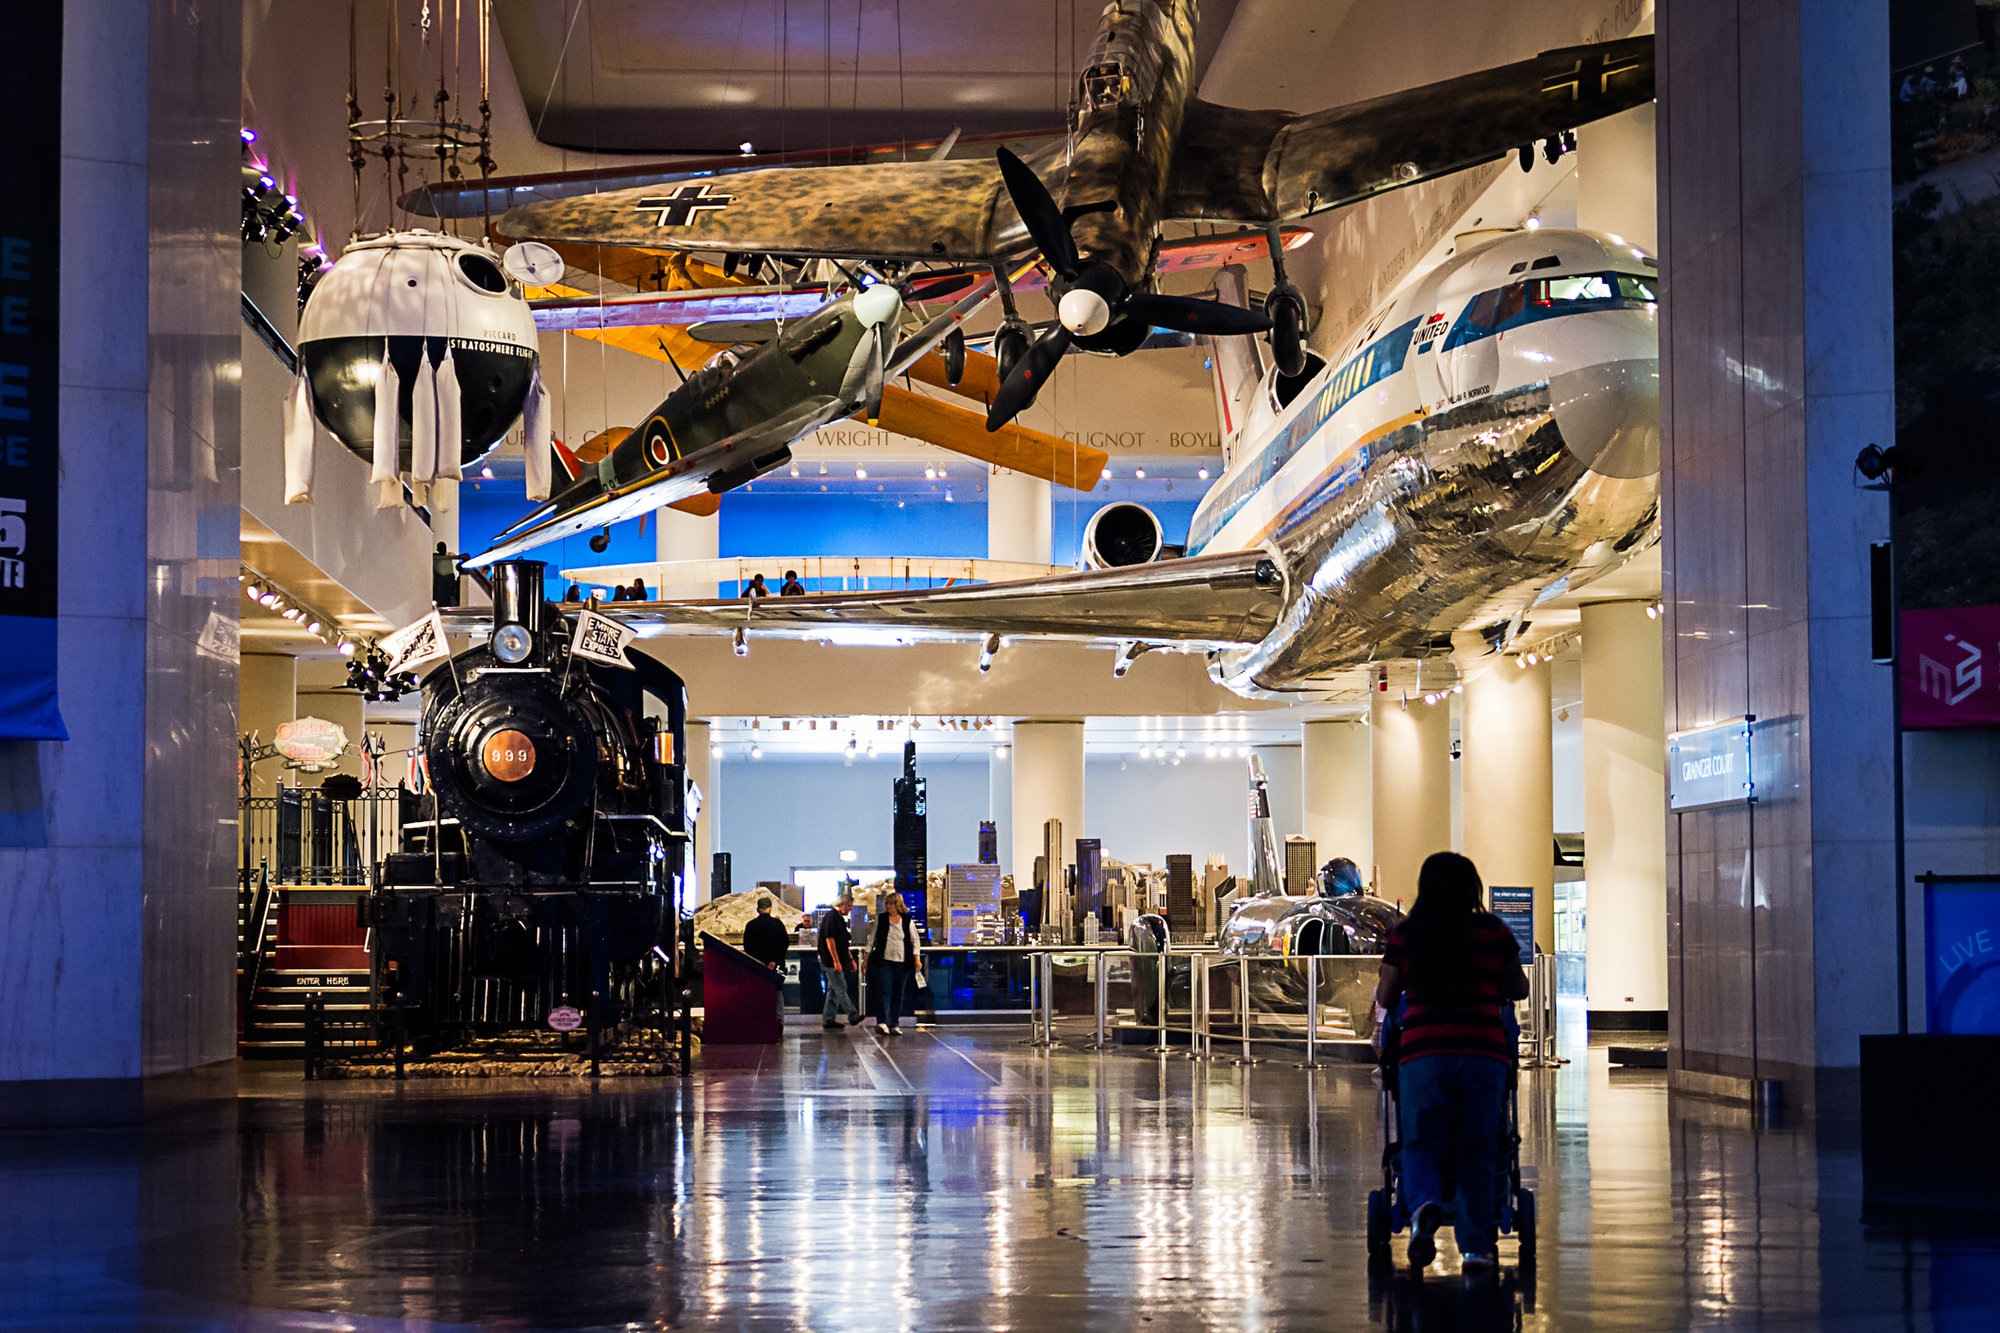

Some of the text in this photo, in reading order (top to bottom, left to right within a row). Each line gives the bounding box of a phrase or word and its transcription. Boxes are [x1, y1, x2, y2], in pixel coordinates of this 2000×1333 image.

[483, 329, 517, 342] PICCARD
[1413, 321, 1449, 345] UNITED
[450, 338, 515, 357] STRATOSPHERE
[815, 431, 892, 447] WRIGHT
[1062, 431, 1146, 448] CUGNOT
[0, 435, 30, 467] E
[587, 618, 621, 643] EMPIRE
[582, 635, 621, 659] EXPRESS
[491, 749, 528, 762] 999
[1682, 756, 1712, 782] GRAINGER
[1938, 929, 1993, 974] LIVE
[296, 976, 350, 986] ENTER HERE
